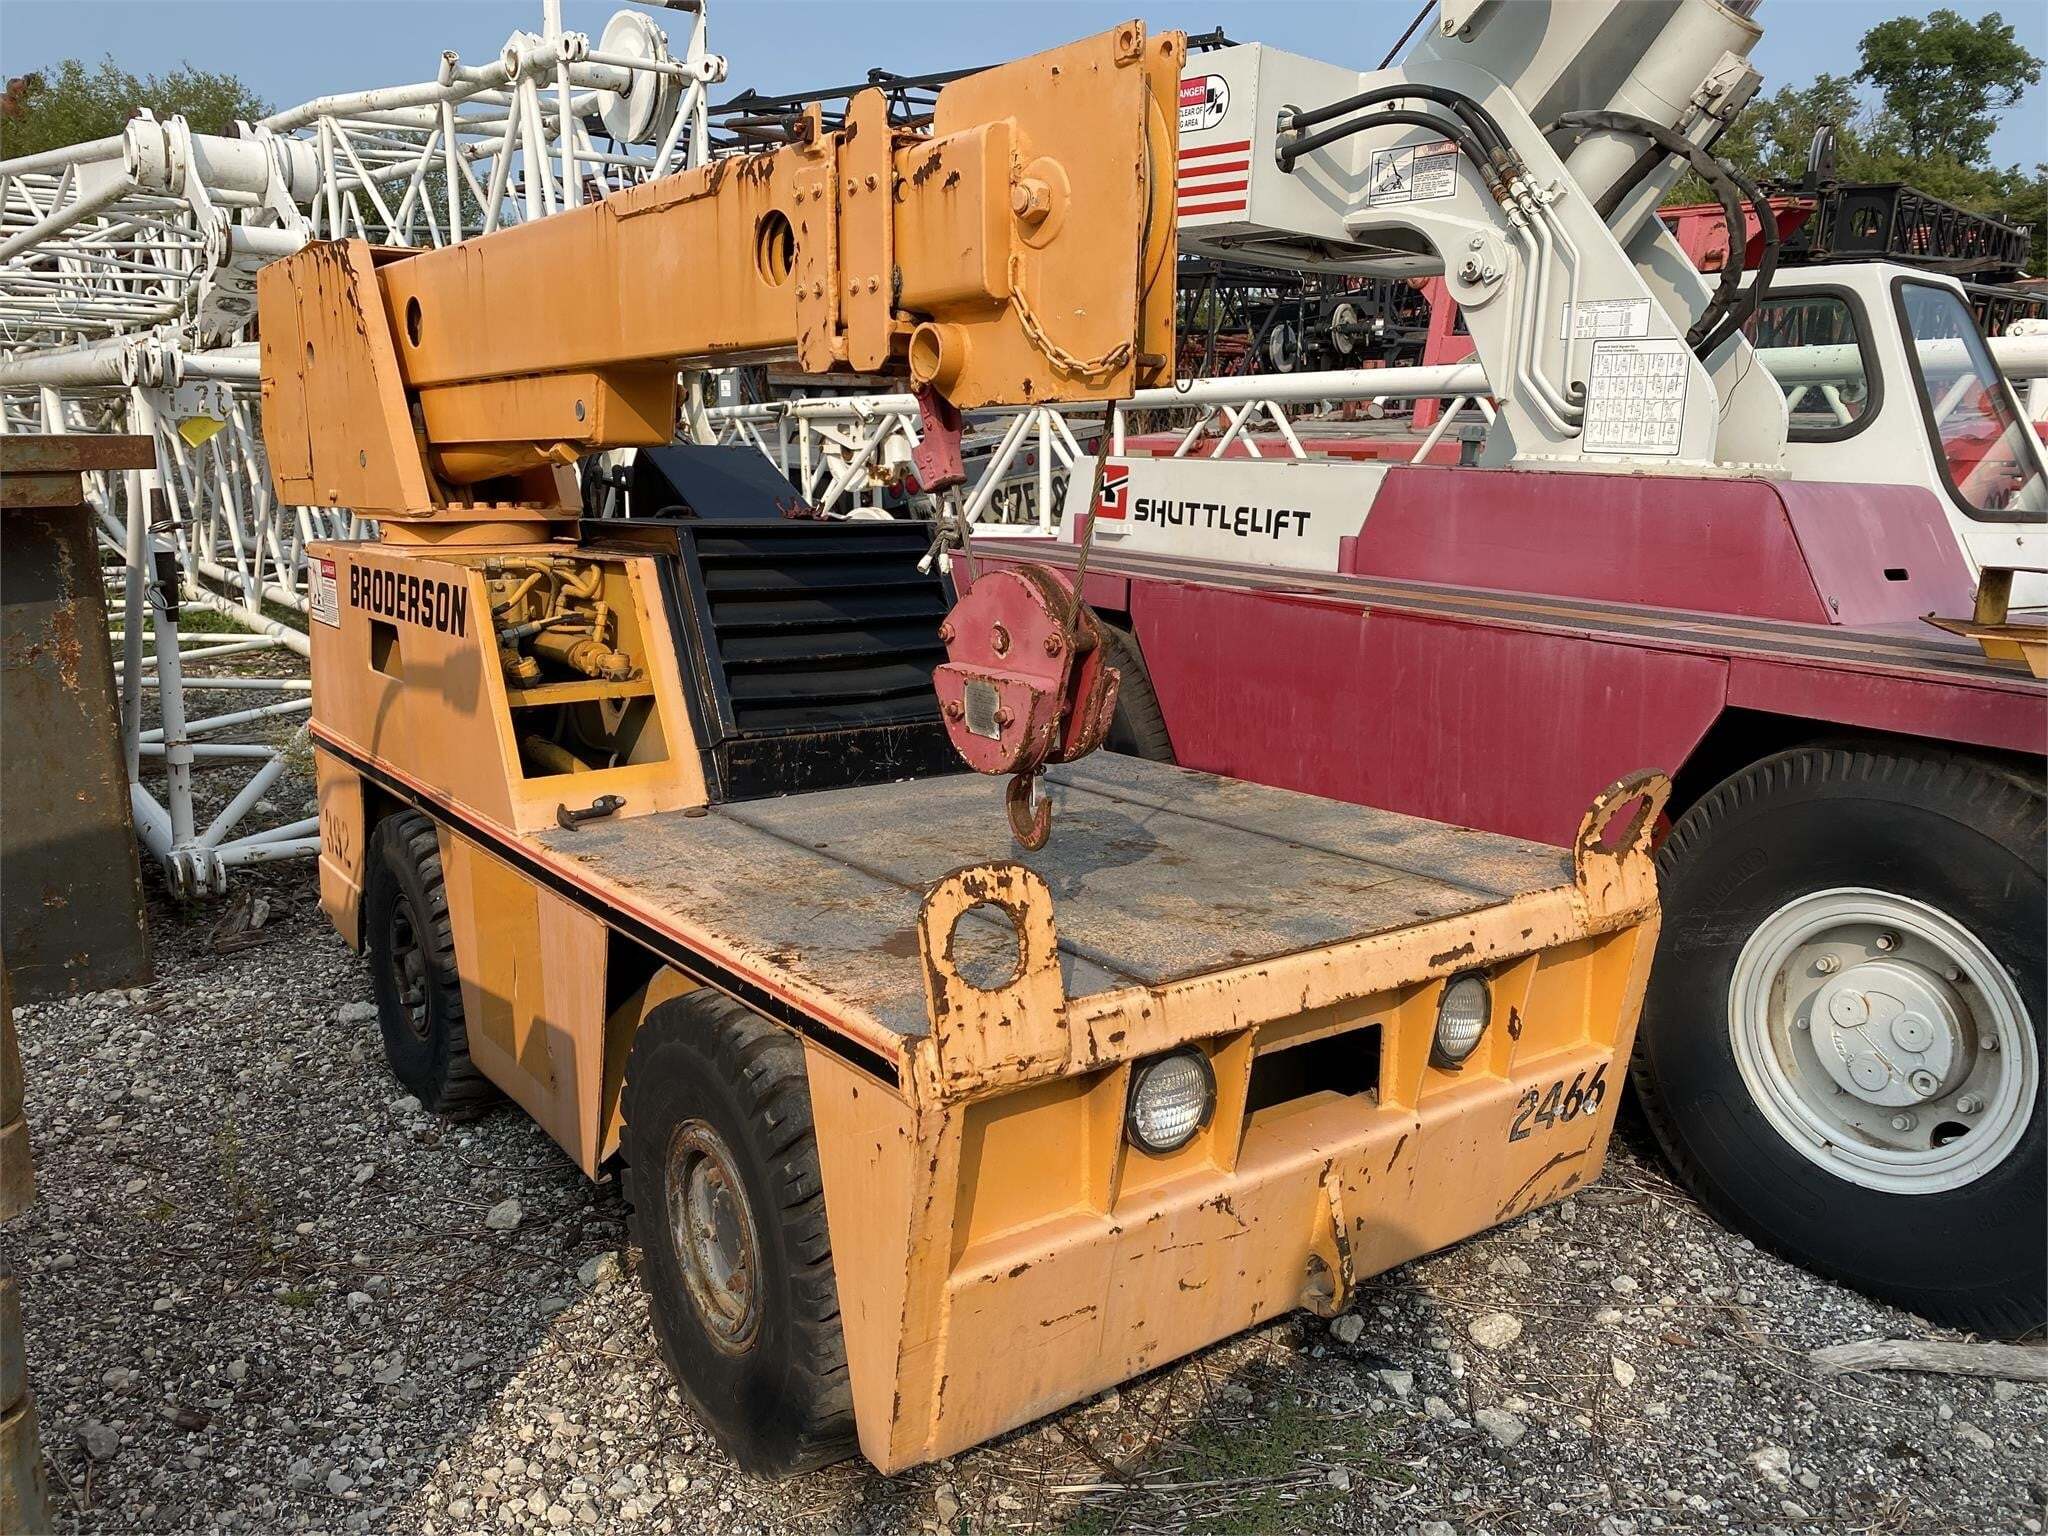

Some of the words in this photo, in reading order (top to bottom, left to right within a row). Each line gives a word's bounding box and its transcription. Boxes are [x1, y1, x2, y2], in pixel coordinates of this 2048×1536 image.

[1180, 86, 1205, 98] ANGER
[1196, 106, 1204, 115] OF
[1185, 119, 1198, 127] AREA
[975, 482, 1040, 524] SIZE
[1134, 498, 1311, 539] SHUTTLELIFT
[350, 564, 468, 638] BRODERSON
[1508, 1062, 1609, 1143] 2466
